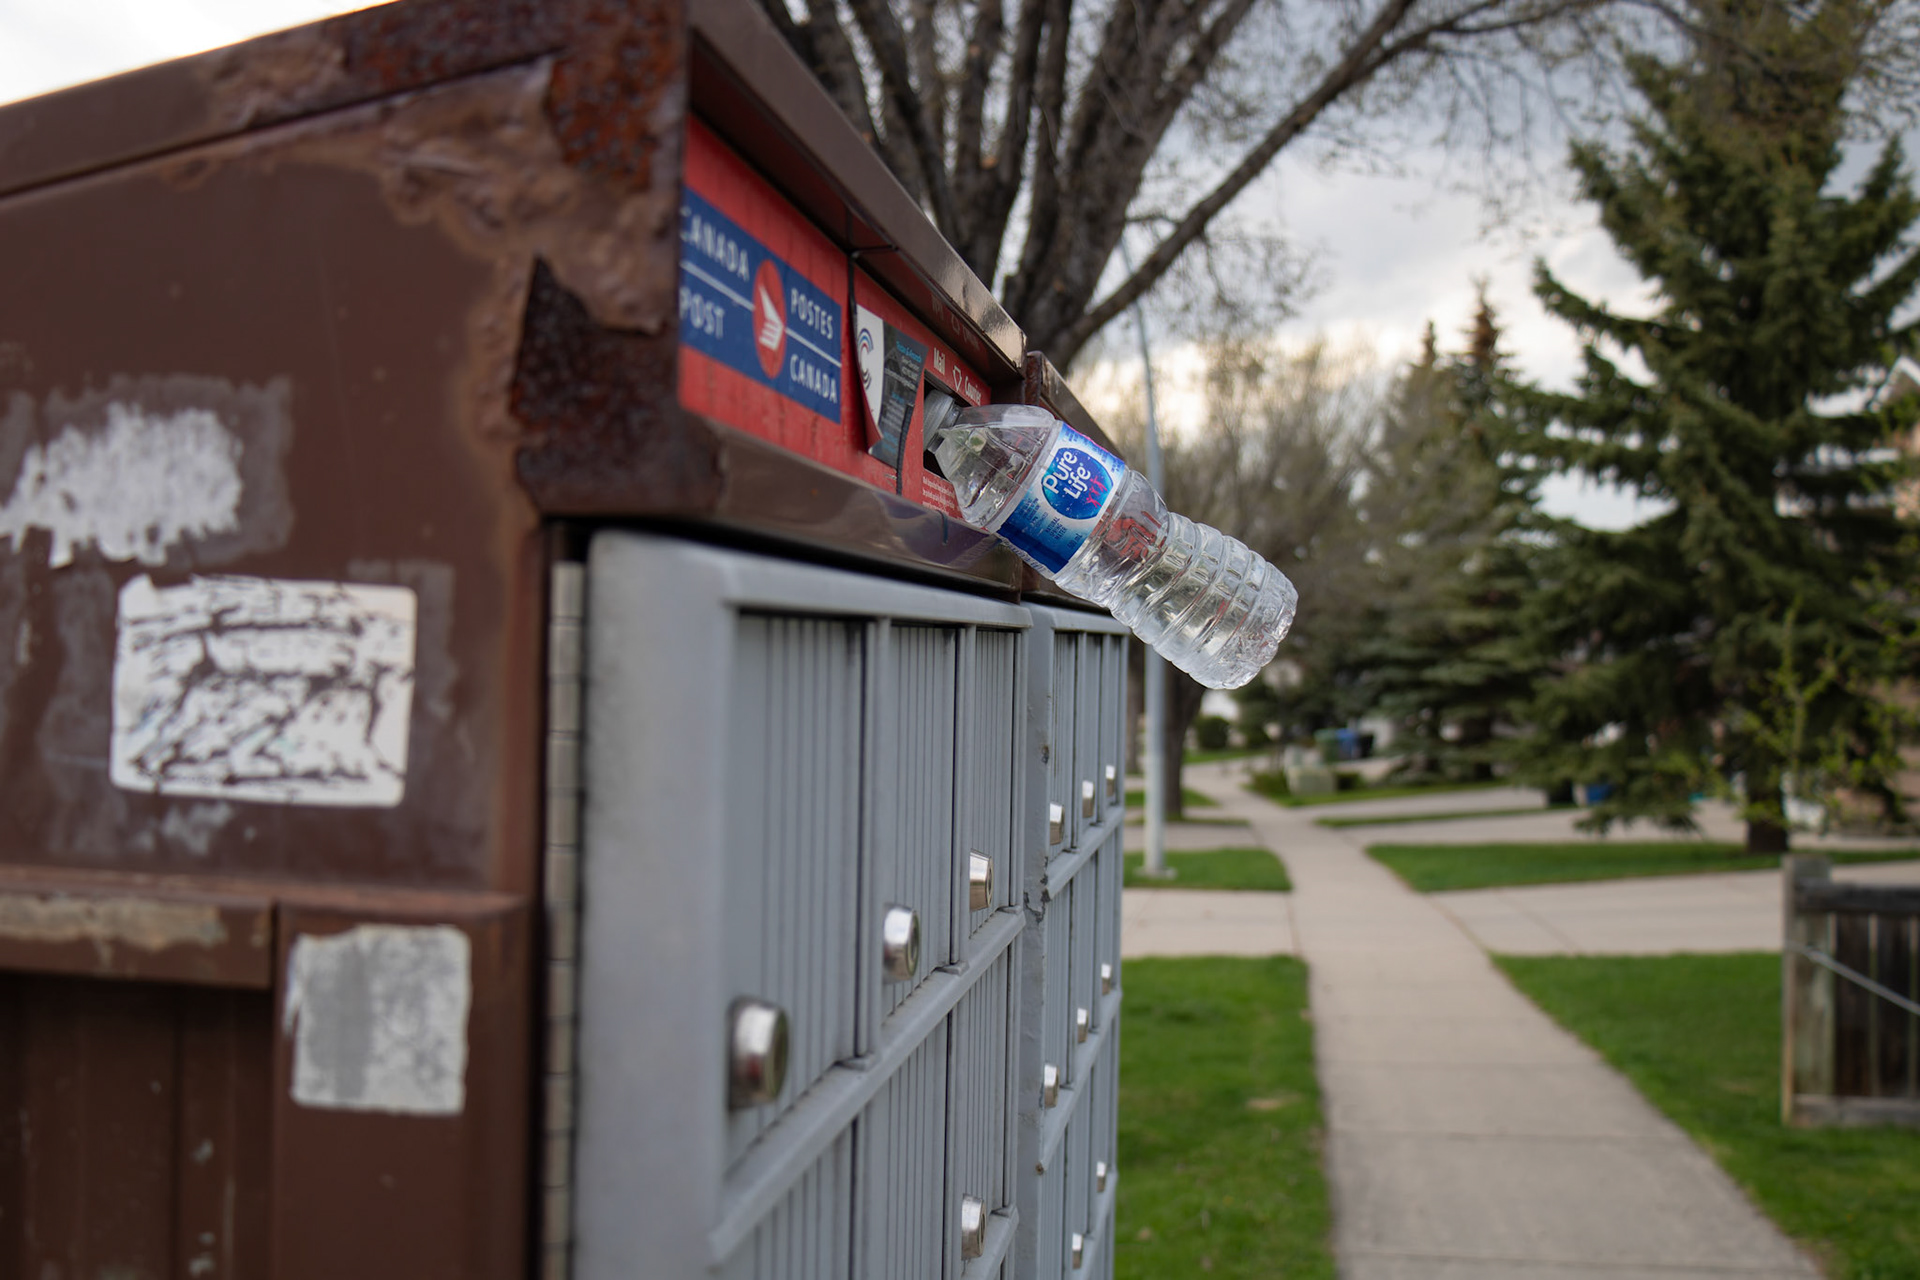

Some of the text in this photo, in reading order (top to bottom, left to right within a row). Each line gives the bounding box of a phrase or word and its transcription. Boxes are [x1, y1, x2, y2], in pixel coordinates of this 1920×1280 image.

[679, 286, 725, 339] POST
[790, 288, 834, 340] POSTES
[789, 354, 838, 403] CANADA
[1042, 450, 1078, 495] Pure
[1063, 465, 1091, 499] Life
